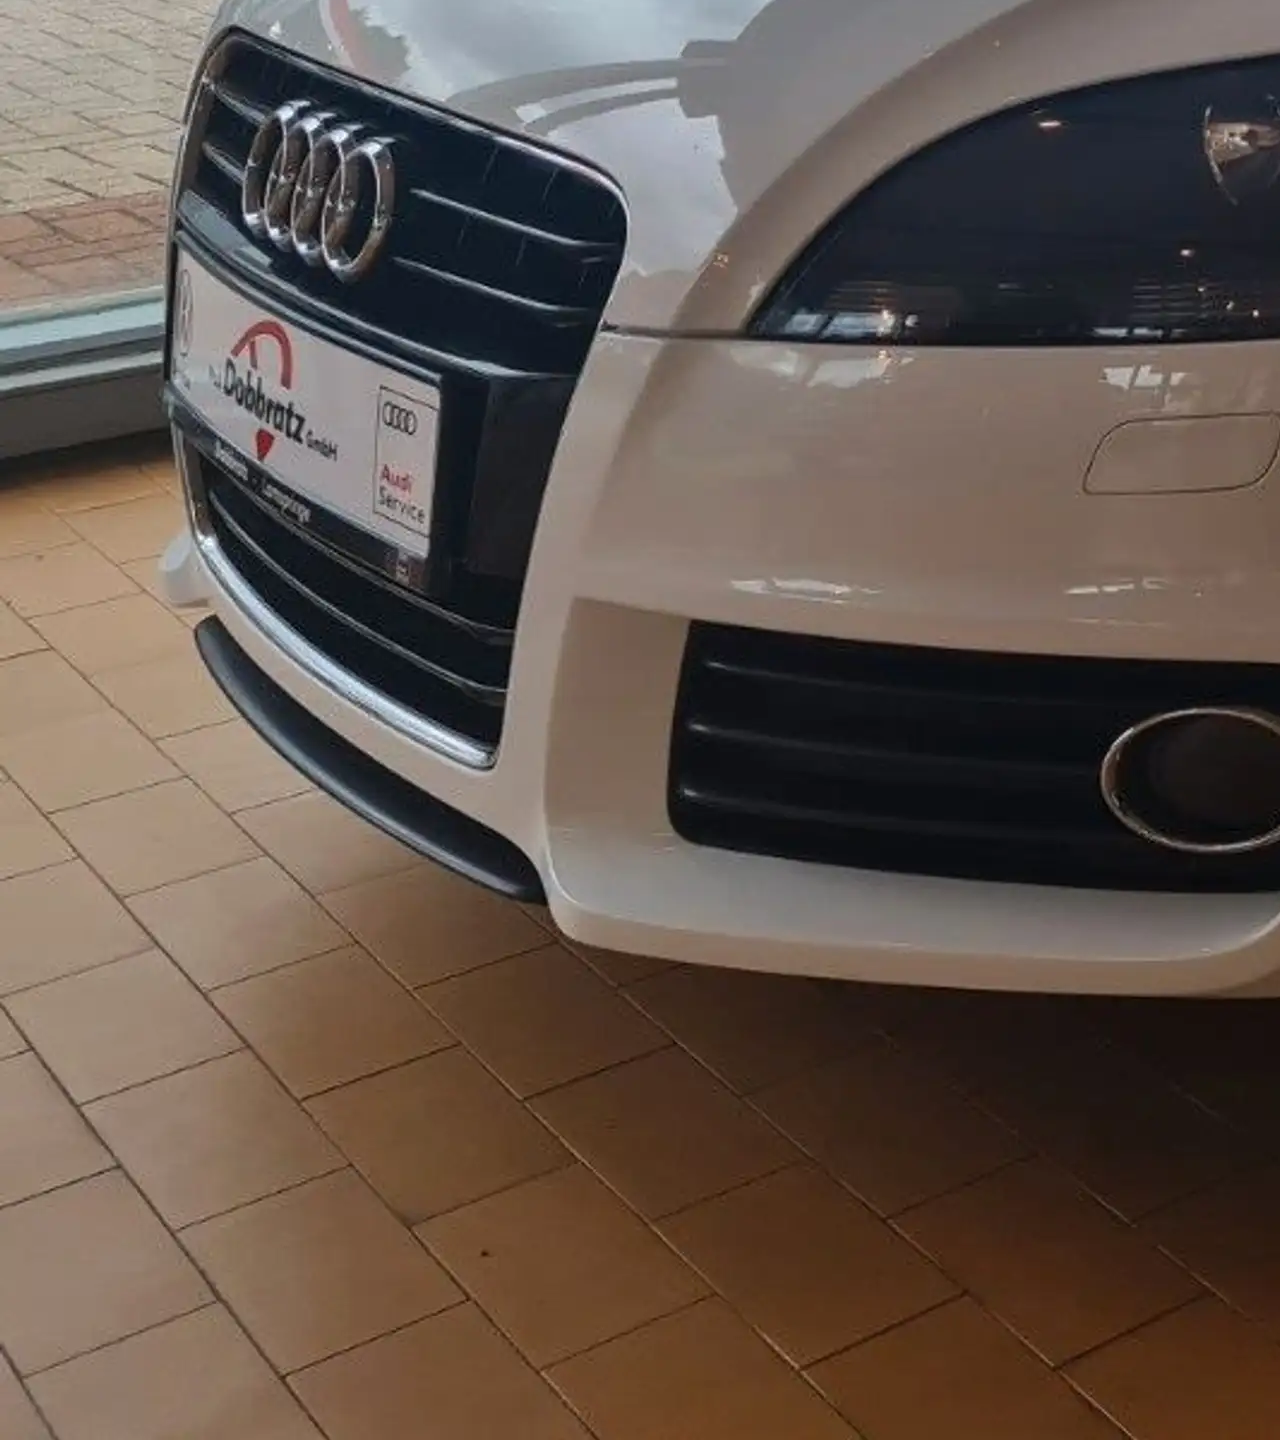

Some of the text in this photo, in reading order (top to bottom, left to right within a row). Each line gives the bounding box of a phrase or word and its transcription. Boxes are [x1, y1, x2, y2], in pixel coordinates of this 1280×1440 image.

[223, 357, 306, 445] Dobbratz
[381, 463, 412, 495] Audi
[379, 485, 425, 525] Service
